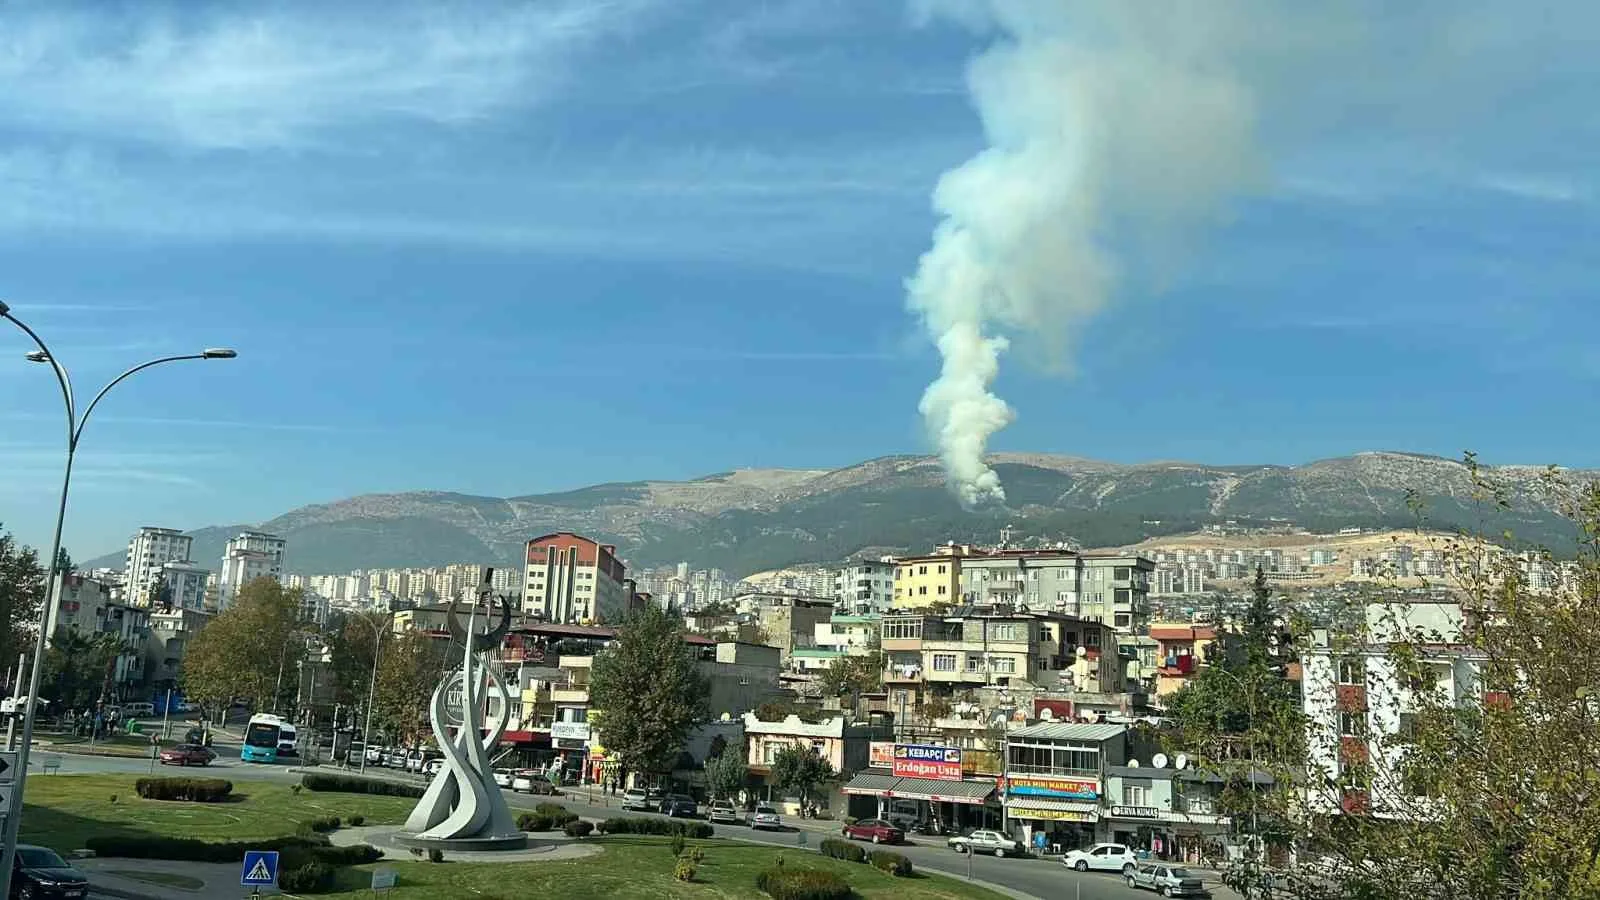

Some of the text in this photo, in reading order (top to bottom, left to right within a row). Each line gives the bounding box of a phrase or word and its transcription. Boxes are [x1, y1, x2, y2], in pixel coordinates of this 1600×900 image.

[909, 748, 943, 760] KEBAPÇI
[896, 762, 937, 775] Erdoğan
[939, 765, 959, 776] Usta
[1049, 782, 1078, 793] MARKET
